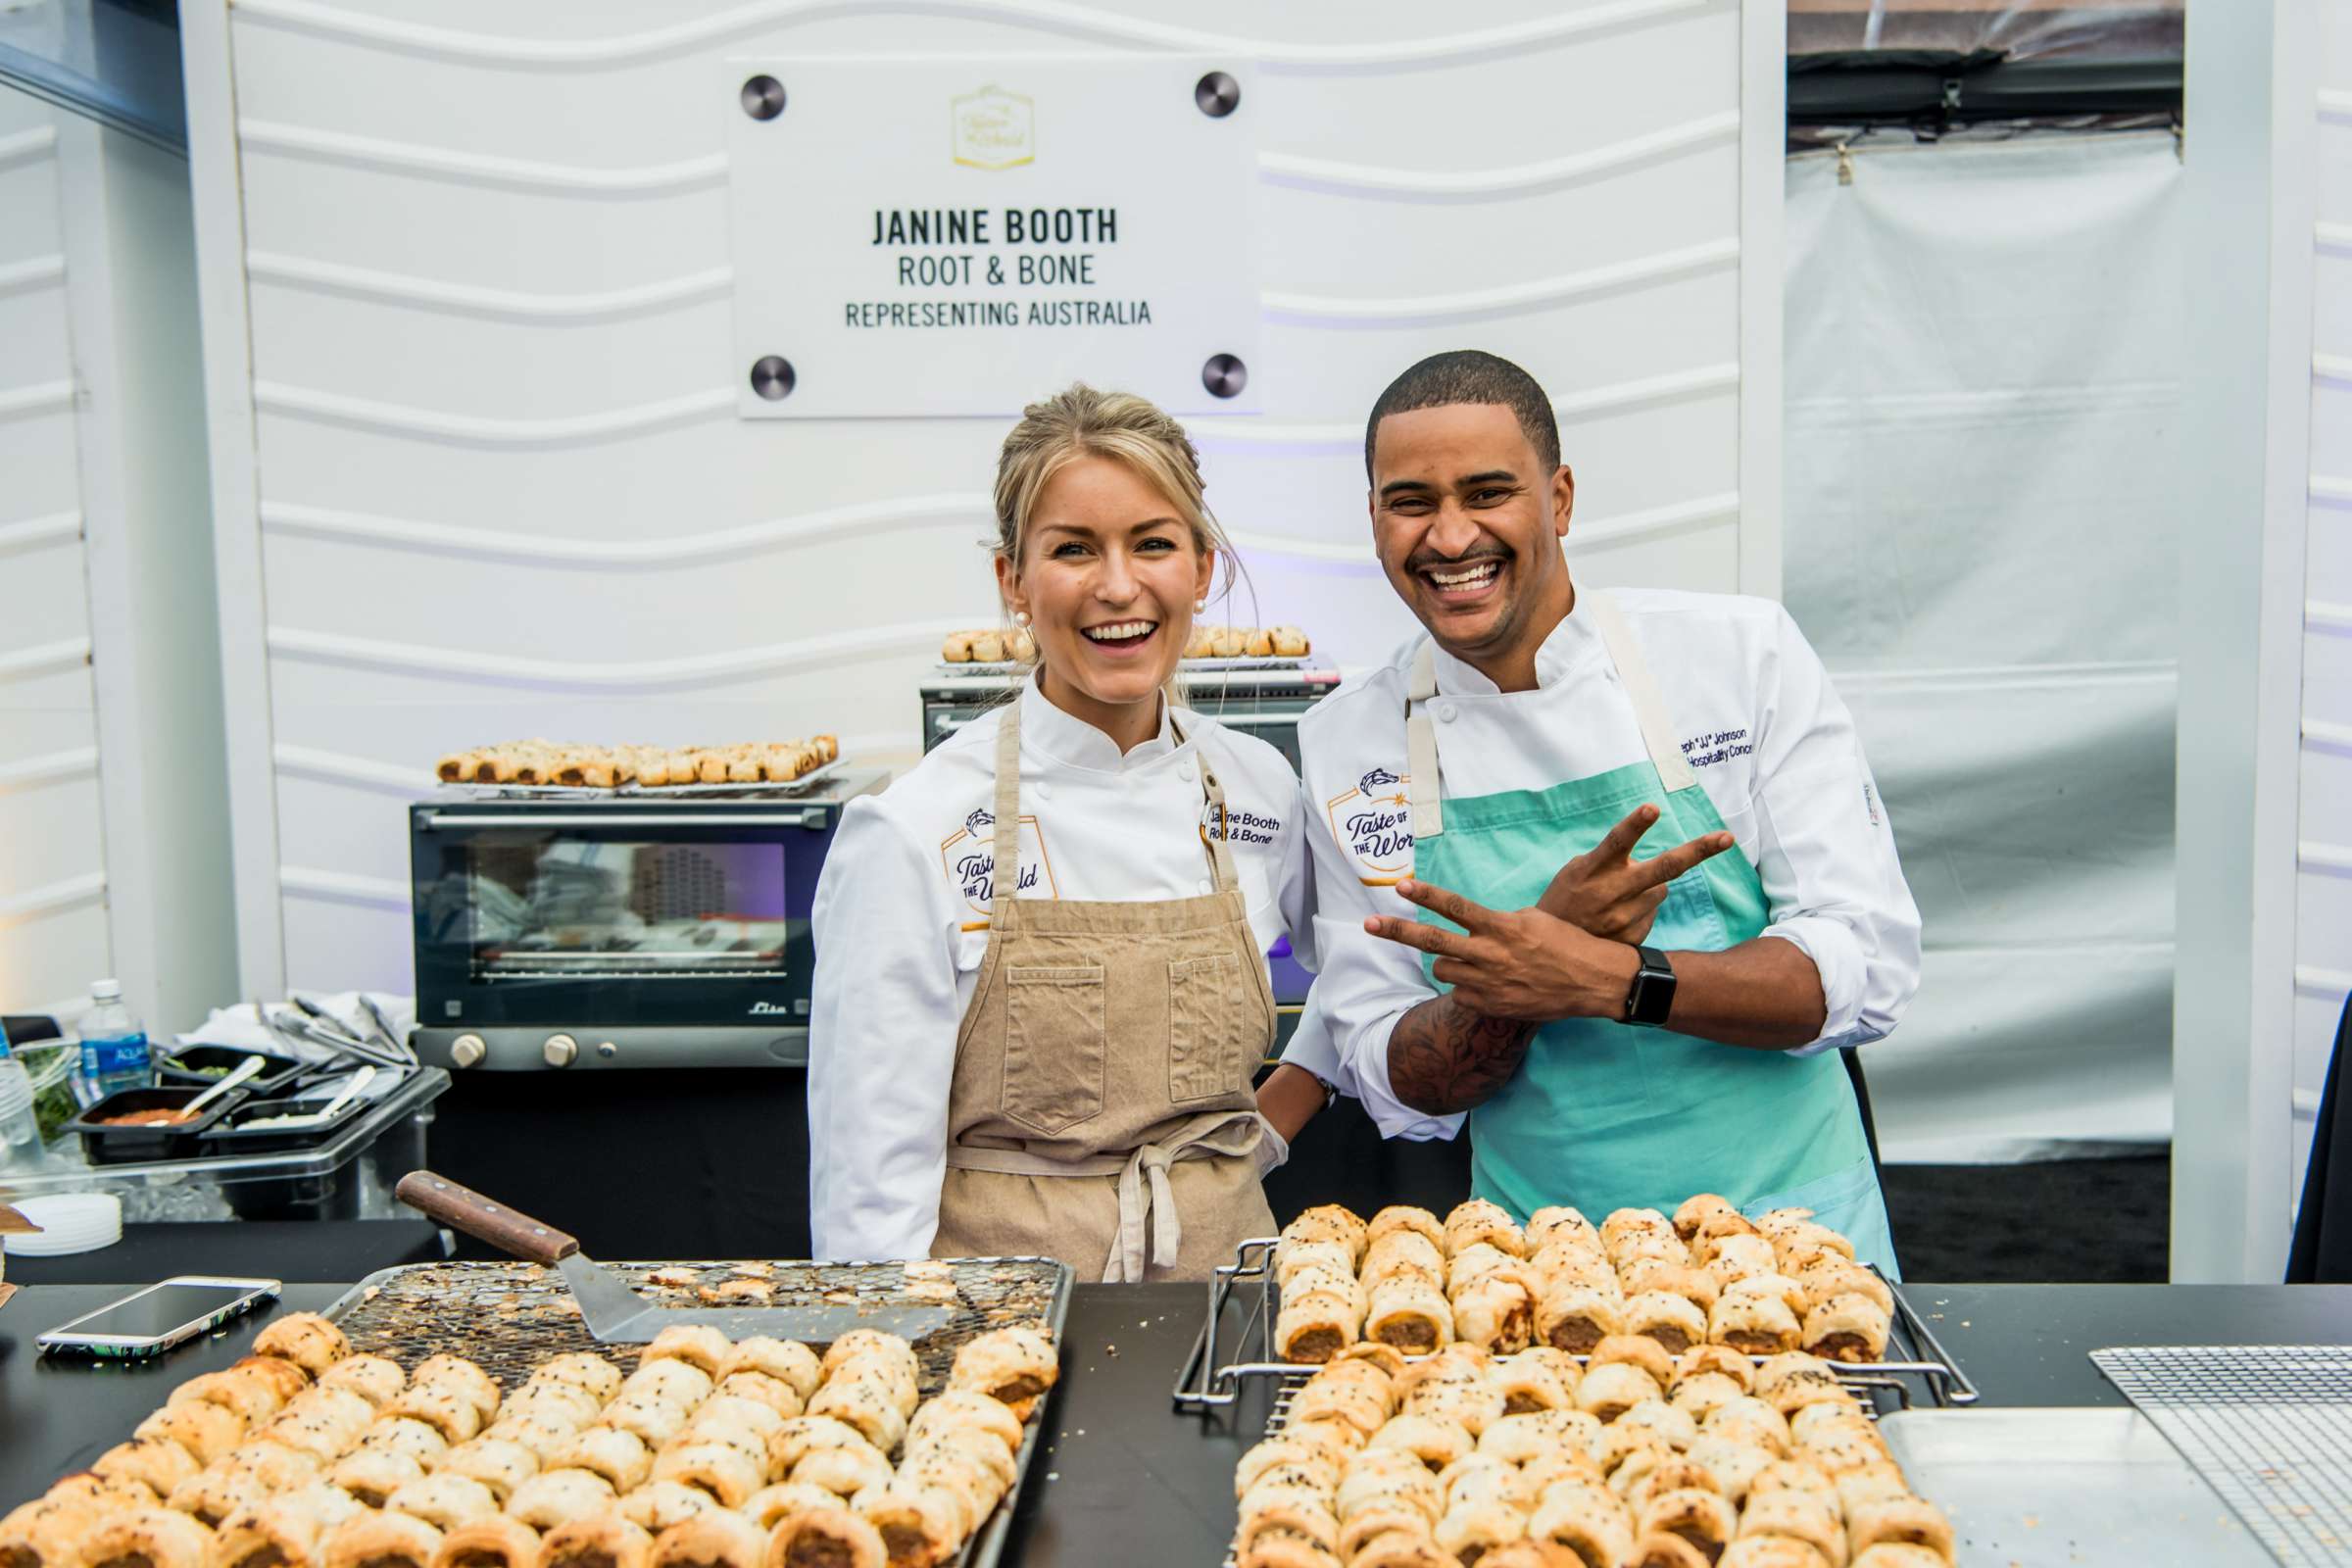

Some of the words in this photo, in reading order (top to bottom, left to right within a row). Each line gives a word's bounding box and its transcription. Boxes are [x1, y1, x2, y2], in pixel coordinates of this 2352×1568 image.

[872, 209, 991, 245] JANINE
[1004, 208, 1116, 243] BOOTH
[899, 255, 974, 286] ROOT
[986, 255, 1005, 286] &
[1018, 254, 1096, 285] BONE
[845, 301, 1019, 327] REPRESENTING
[1028, 300, 1152, 326] AUSTRALIA
[1713, 728, 1747, 745] Johnson
[1209, 809, 1241, 824] Jane
[1242, 812, 1280, 831] Booth
[1346, 810, 1396, 842] Taste
[1396, 810, 1407, 823] OF
[1230, 827, 1240, 840] &
[1240, 828, 1273, 845] Bone
[1353, 842, 1371, 856] THE
[963, 885, 978, 899] THE
